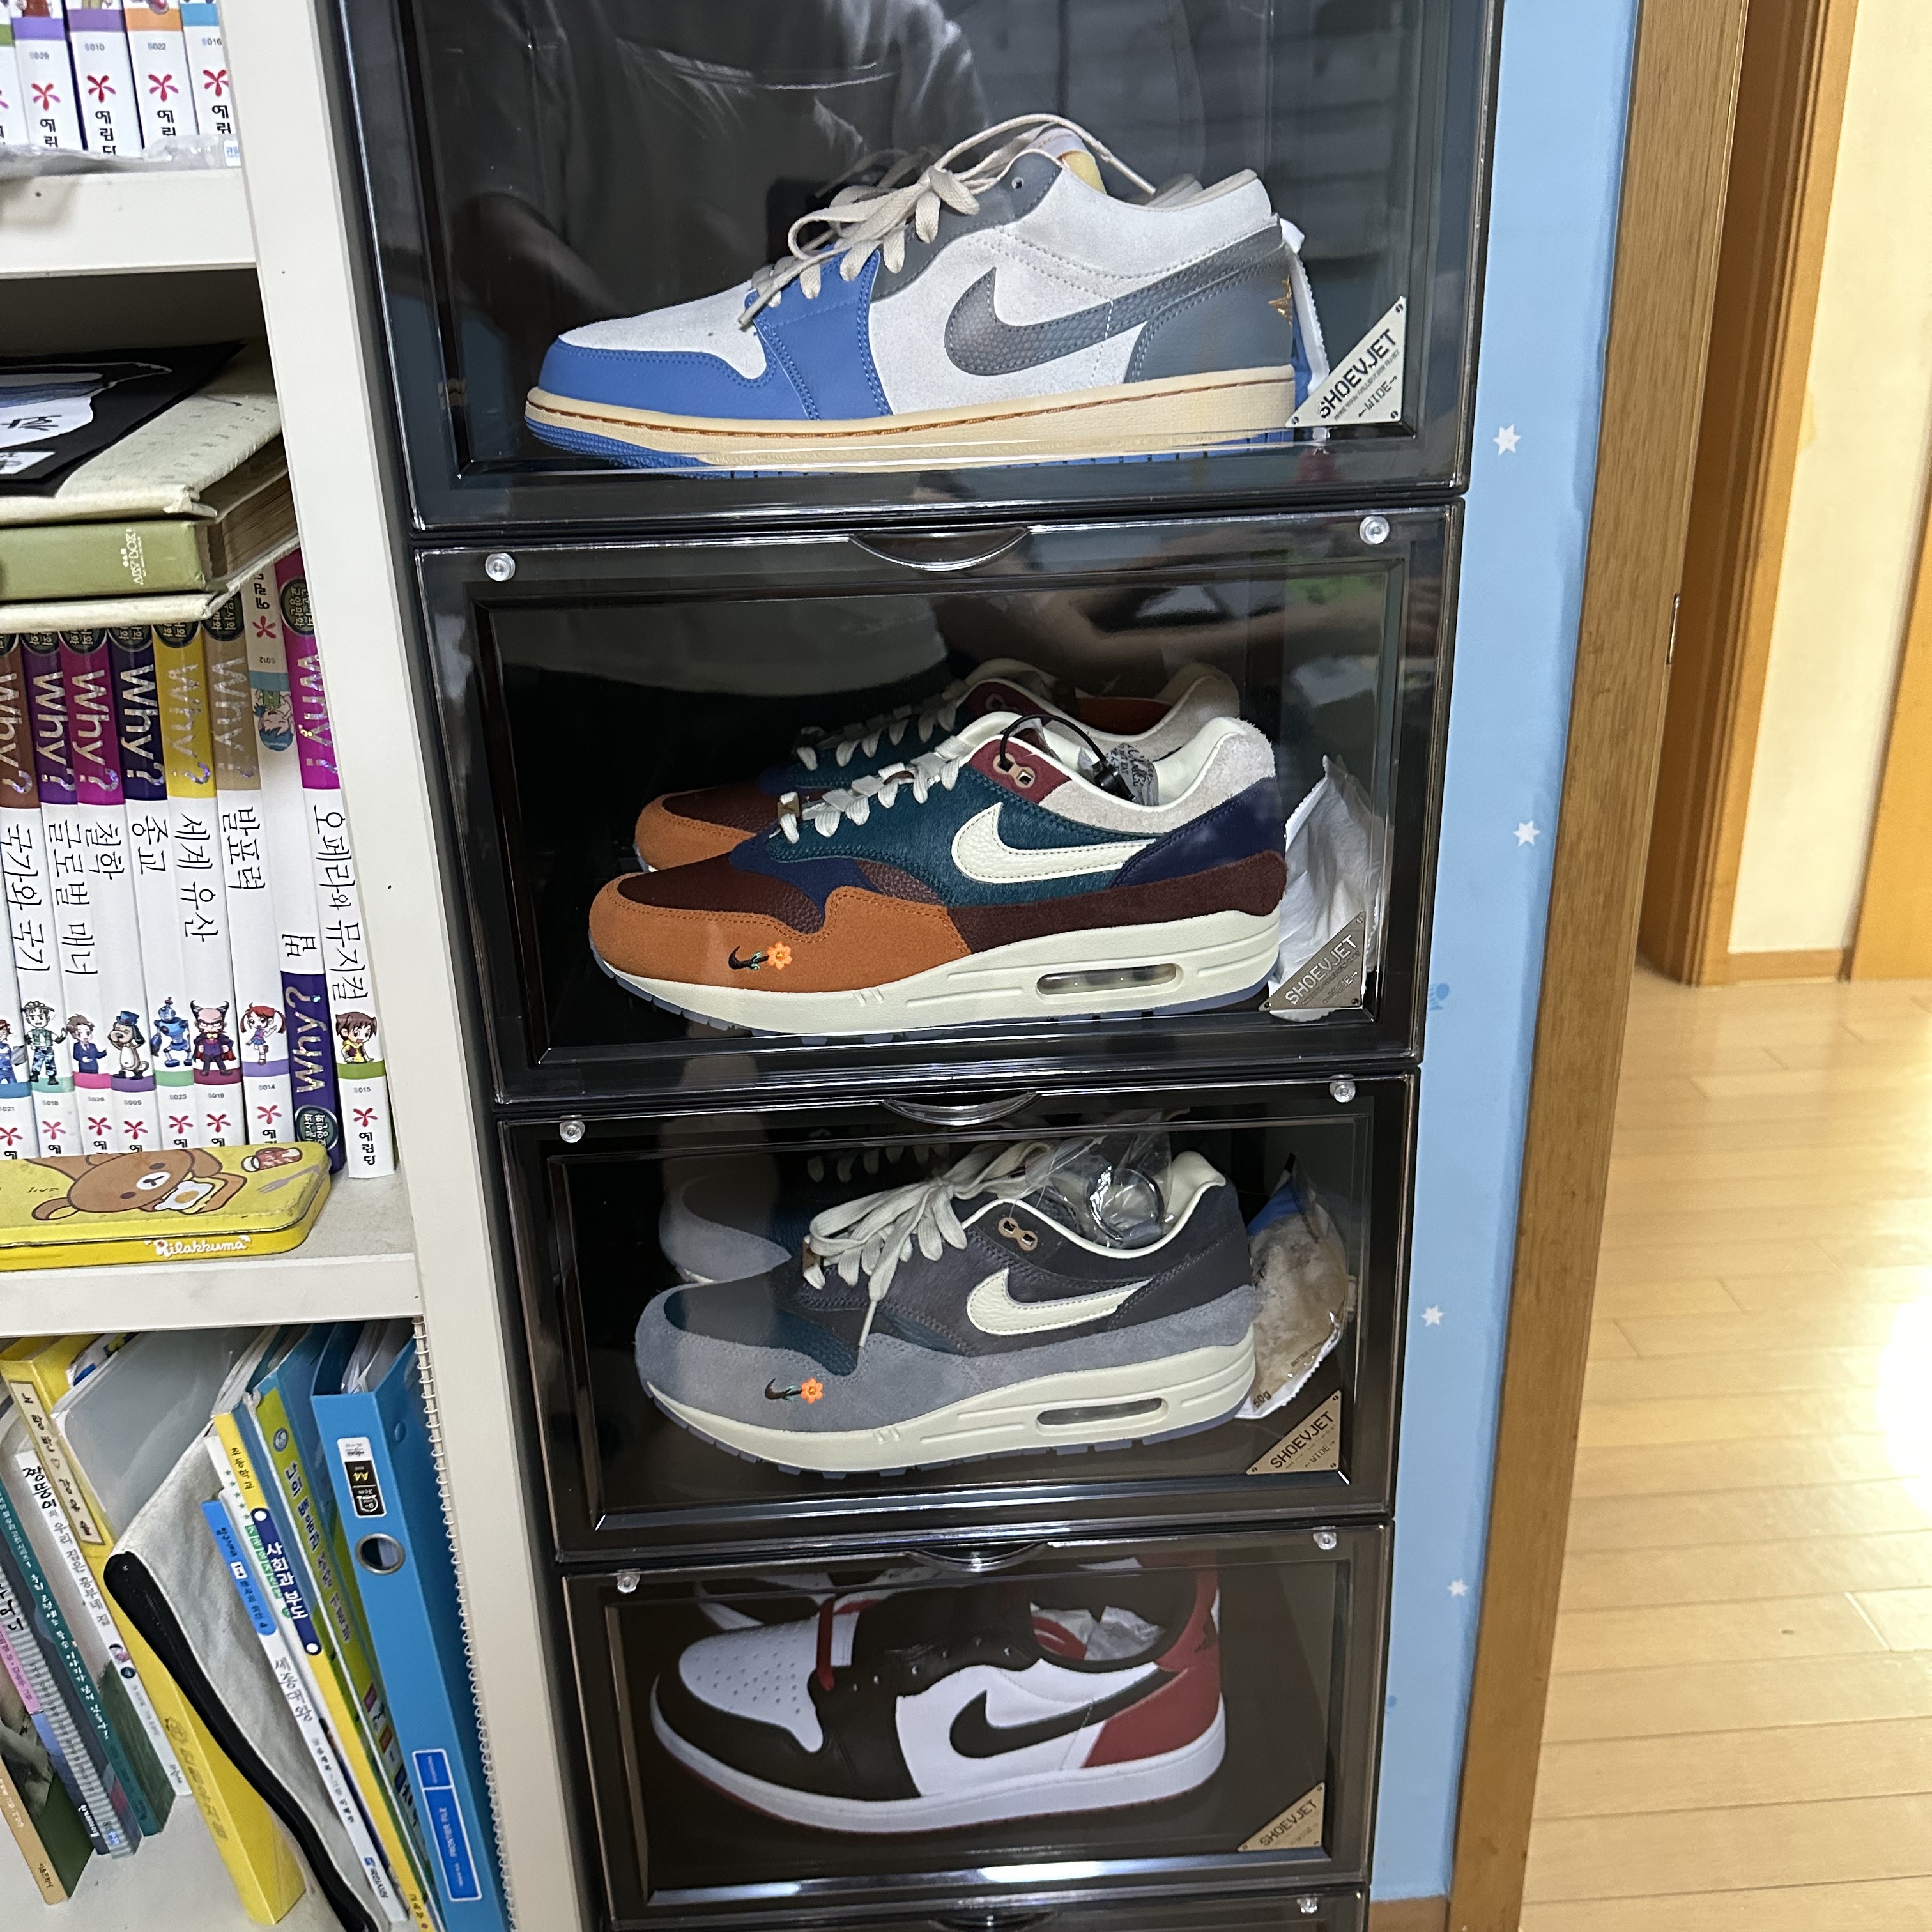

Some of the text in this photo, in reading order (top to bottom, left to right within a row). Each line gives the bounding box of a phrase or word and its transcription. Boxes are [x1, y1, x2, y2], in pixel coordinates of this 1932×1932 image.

[1316, 328, 1396, 418] SHOEVJET
[1364, 380, 1392, 411] WIDE
[33, 671, 75, 792] Why?
[72, 670, 119, 792] Why?
[120, 664, 166, 786] Why?
[167, 663, 211, 785] Why?
[211, 656, 256, 778] Why?
[85, 821, 125, 880] 철학
[132, 815, 169, 875] 종교
[174, 813, 218, 942] 세계 유산
[222, 806, 266, 889] 발표력
[1, 824, 50, 971] 국가와 국기
[49, 819, 98, 974] 글로벌 매너
[313, 804, 369, 1000] 오페라와 뮤지컬
[282, 933, 318, 958] 법
[1285, 935, 1356, 1004] SHOEVJET
[287, 986, 327, 1092] Why?
[359, 1131, 376, 1166] 예림당
[154, 1238, 247, 1257] Rilakkuma
[1270, 1411, 1333, 1468] SHOEVJET
[266, 1542, 309, 1620] 사회과 부도
[1259, 1799, 1317, 1846] SHOEVJET
